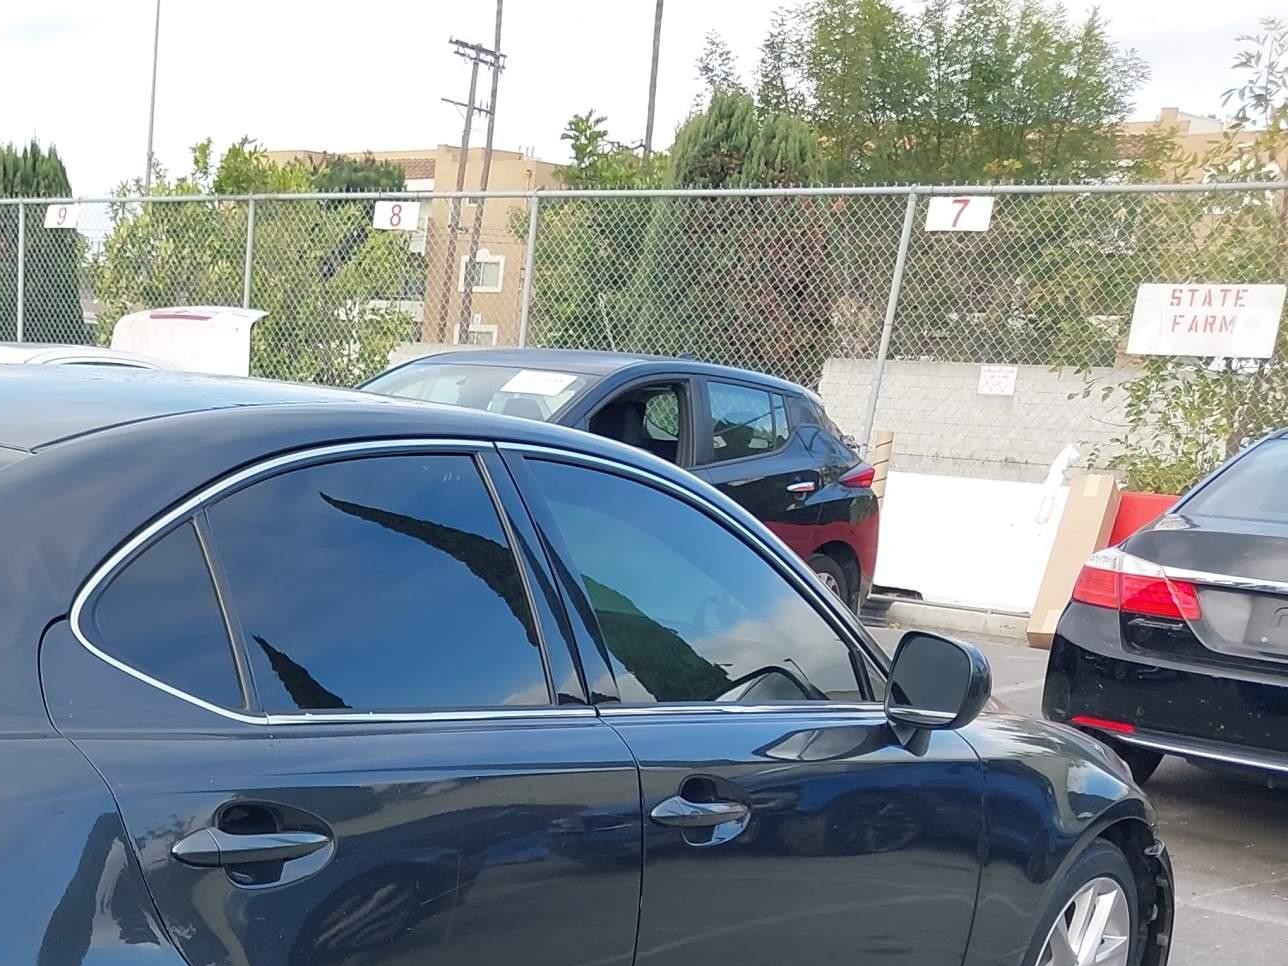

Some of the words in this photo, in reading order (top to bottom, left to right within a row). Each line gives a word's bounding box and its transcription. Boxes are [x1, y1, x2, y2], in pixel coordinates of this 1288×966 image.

[56, 206, 67, 226] 9
[390, 204, 402, 226] 8
[952, 199, 970, 227] 7
[1169, 288, 1248, 307] STATE
[1170, 314, 1237, 334] FARM
